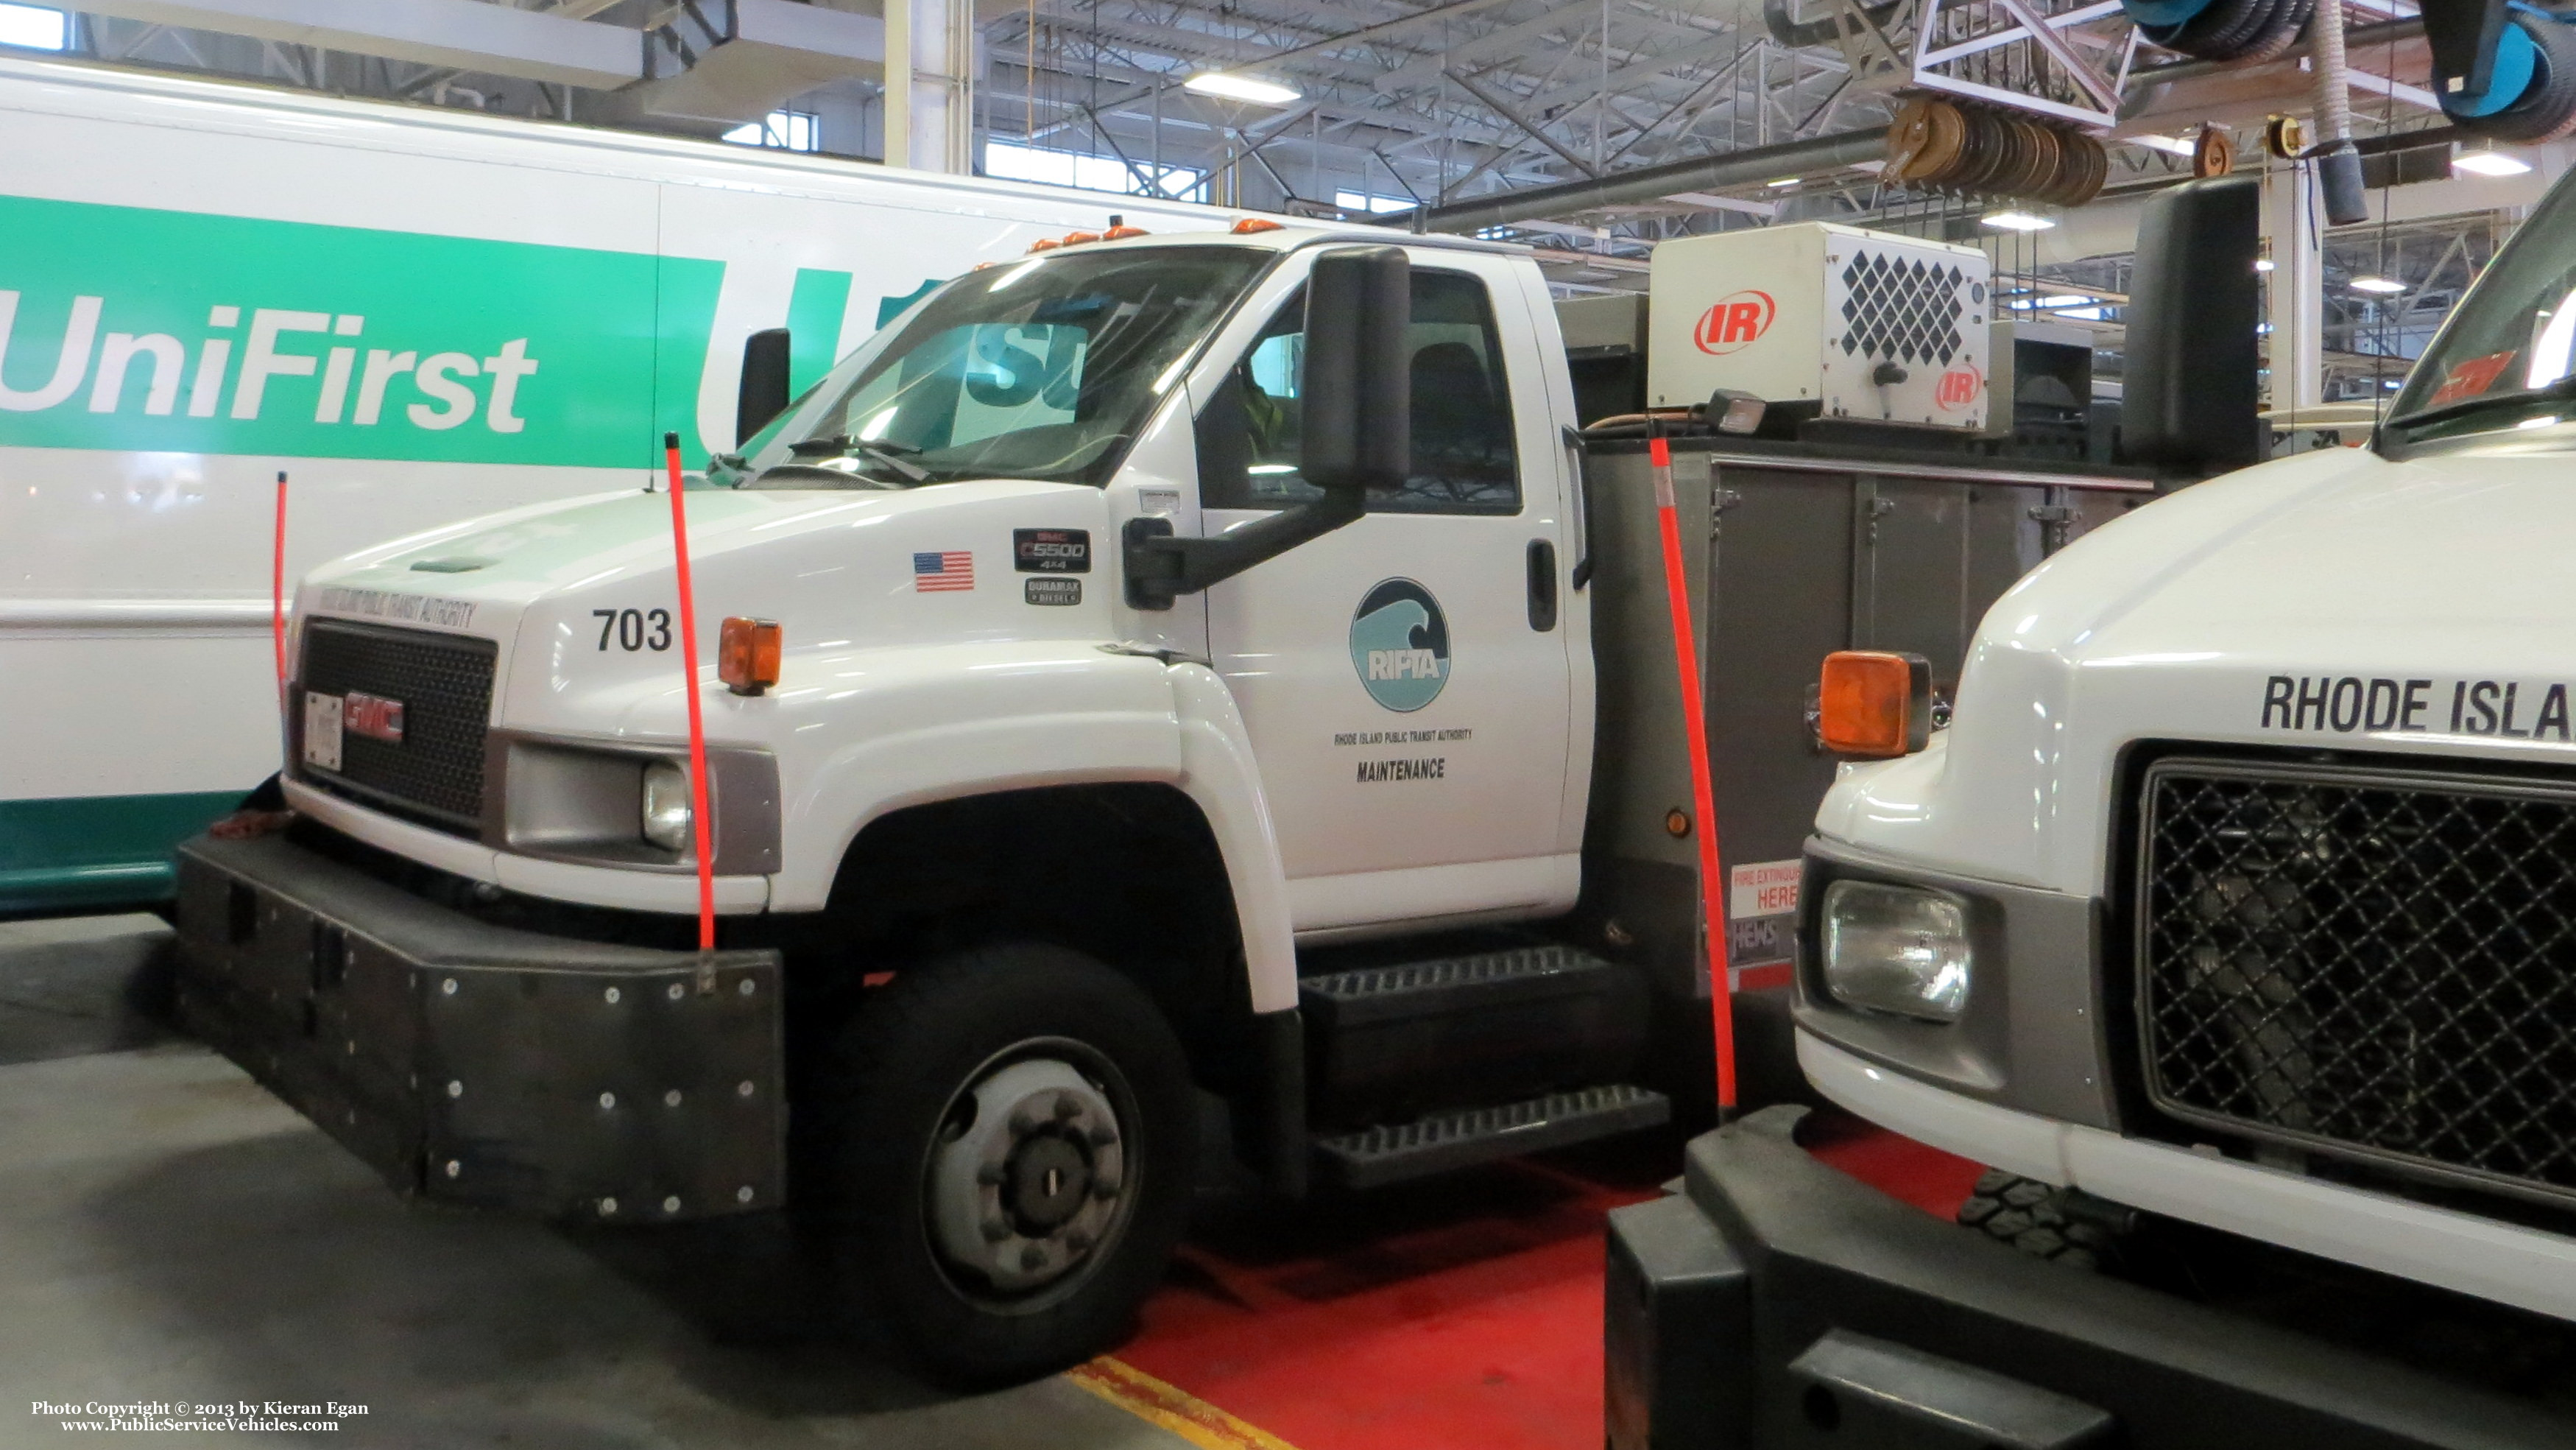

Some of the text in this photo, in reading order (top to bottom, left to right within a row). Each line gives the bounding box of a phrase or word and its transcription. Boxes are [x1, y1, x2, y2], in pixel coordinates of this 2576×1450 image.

[1707, 303, 1762, 343] IR
[0, 290, 539, 434] UniFirst
[1020, 543, 1085, 557] C5500
[1028, 581, 1079, 591] DURAMAX
[1039, 594, 1068, 602] DIESEL
[593, 608, 671, 652] 703
[1368, 648, 1441, 681] RIPTA
[2261, 675, 2576, 742] RHODE ISLA
[1334, 728, 1472, 745] RHODE ISLAND PUBLIC TRANSIT AUTHORITY
[1357, 758, 1445, 783] MAINTENANCE
[1758, 885, 1798, 909] HERE
